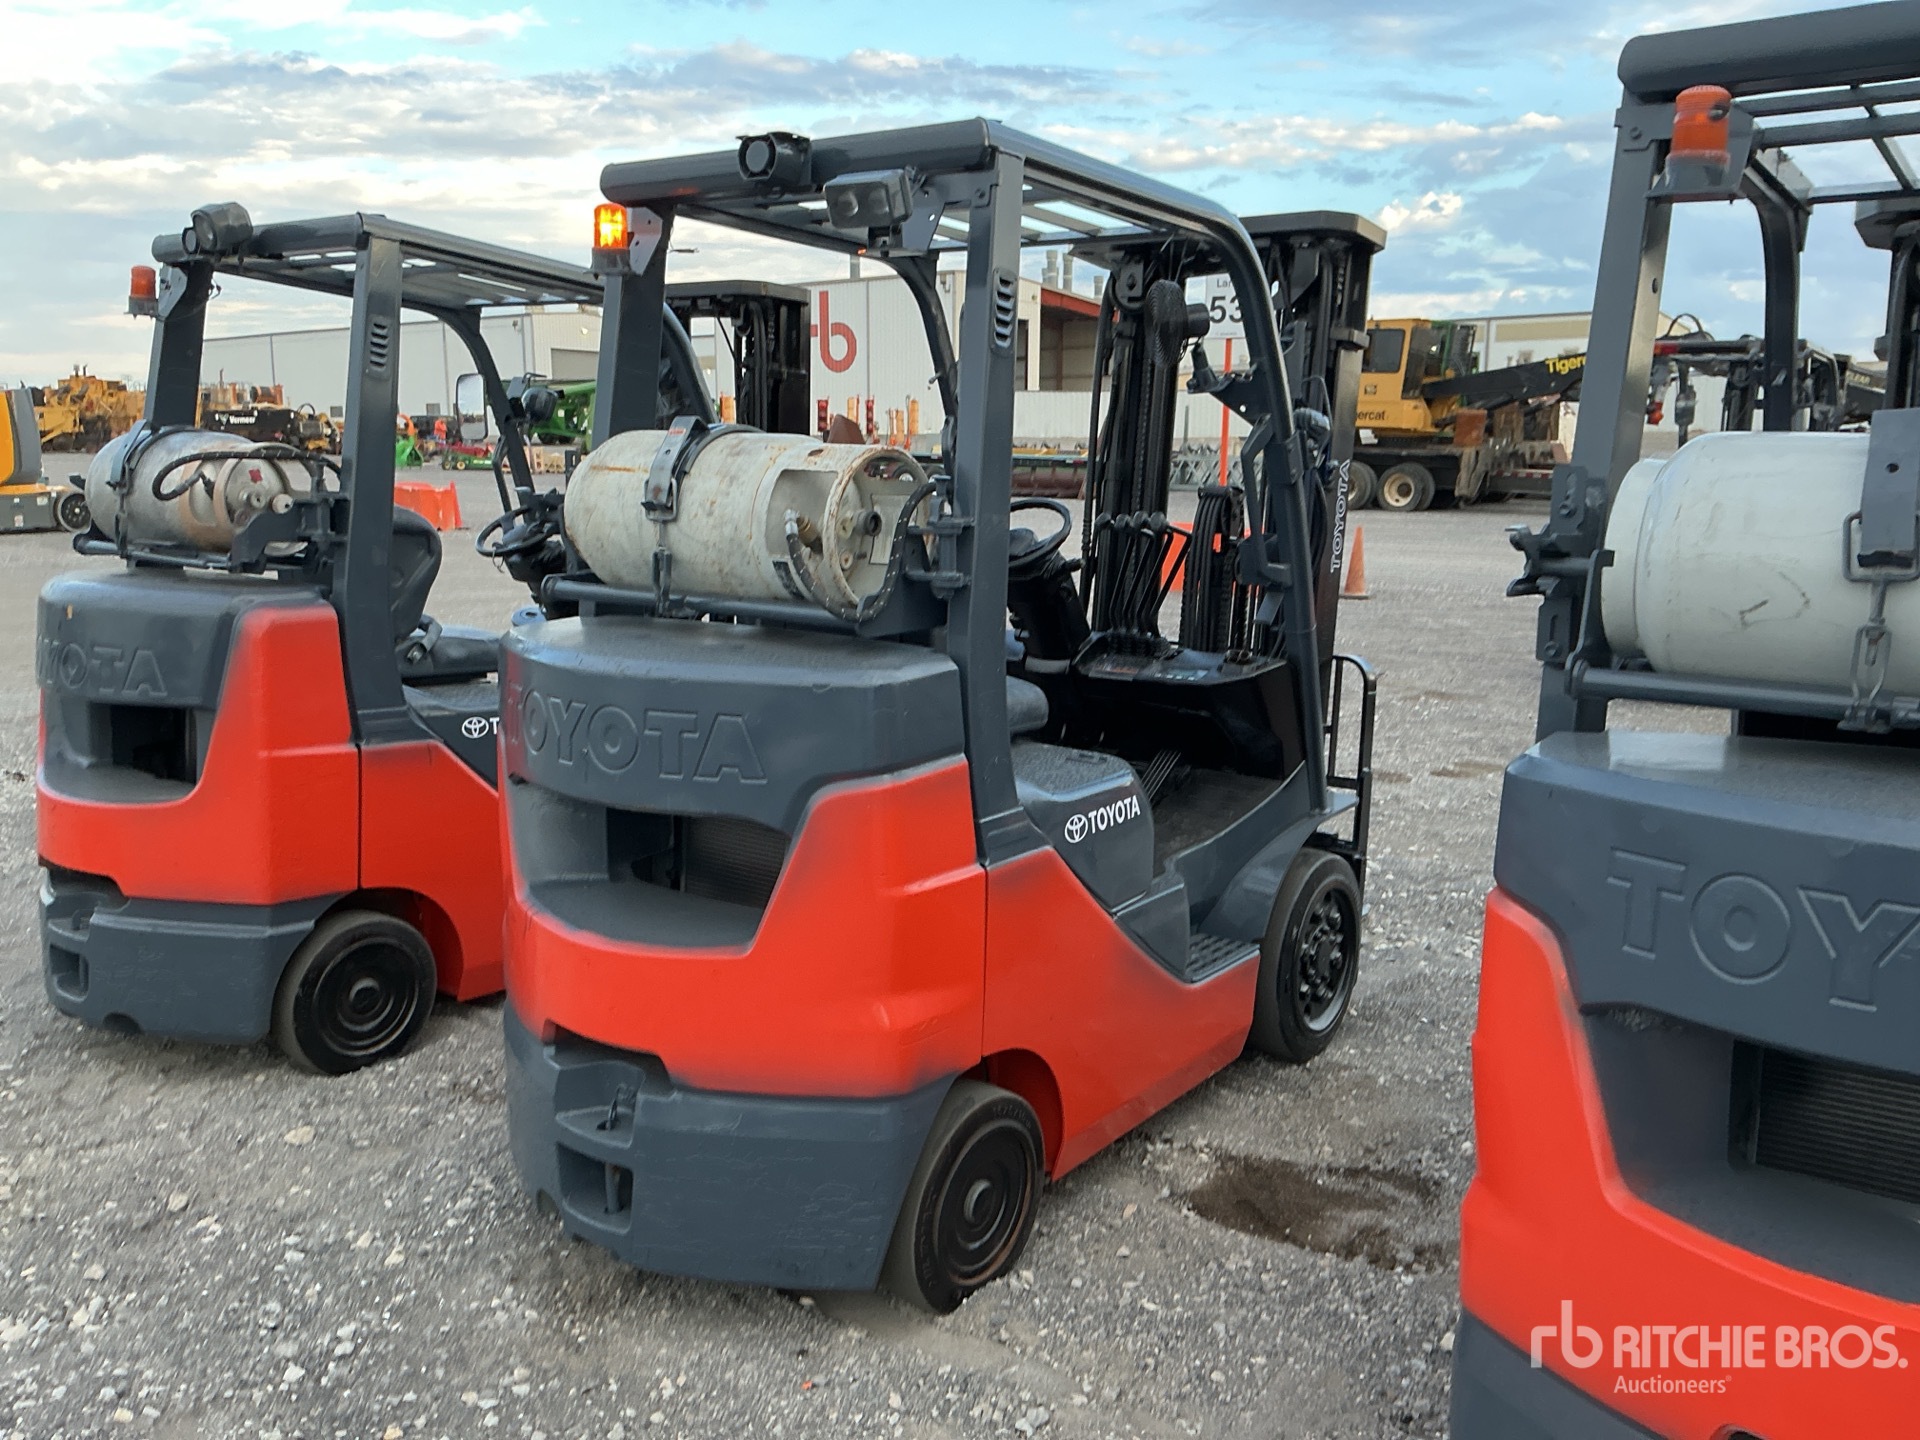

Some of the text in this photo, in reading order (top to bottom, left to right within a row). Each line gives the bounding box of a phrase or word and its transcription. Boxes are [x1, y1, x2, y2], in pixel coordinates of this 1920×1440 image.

[1330, 459, 1350, 573] TOYOTA
[507, 681, 768, 785] TOYOTA
[1088, 794, 1141, 834] TOYOTA
[1606, 846, 1920, 1013] TOY
